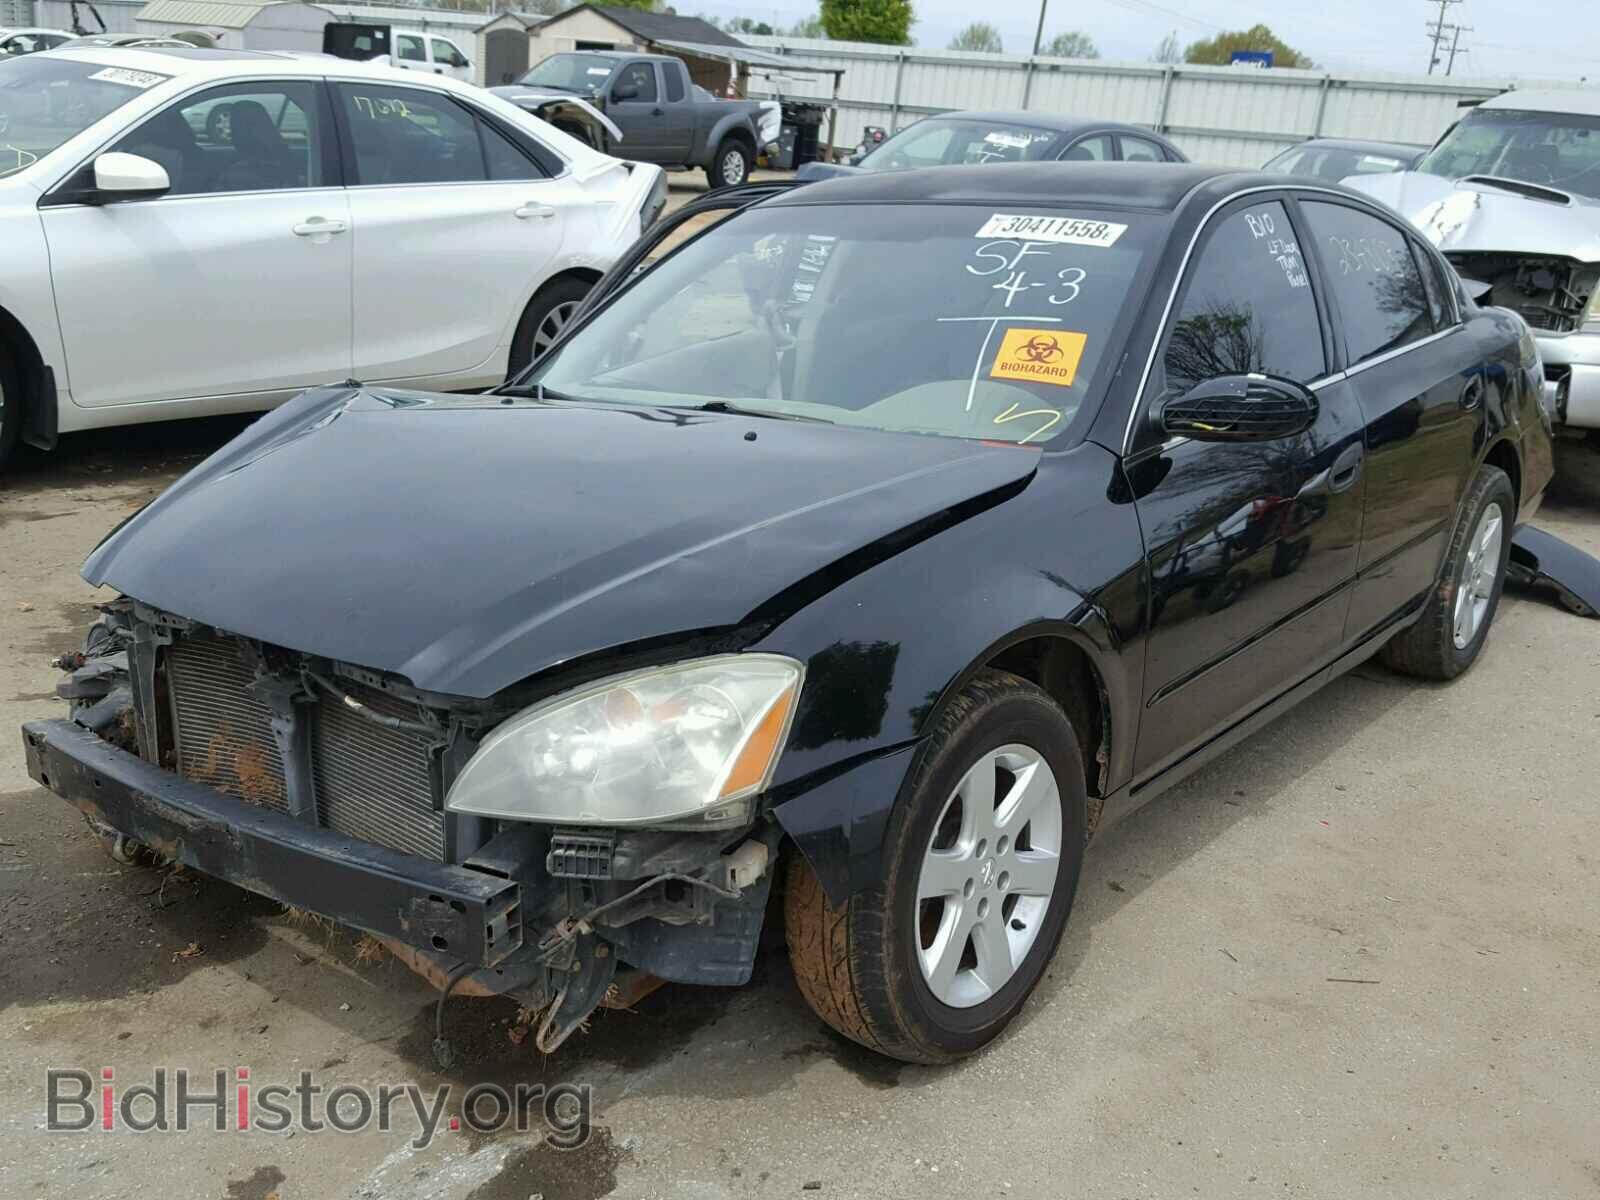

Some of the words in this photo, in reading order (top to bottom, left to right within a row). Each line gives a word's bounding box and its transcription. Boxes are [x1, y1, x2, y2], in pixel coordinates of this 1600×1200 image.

[1002, 216, 1109, 240] 30411558
[965, 238, 1060, 276] SF
[992, 267, 1087, 309] 4-3
[1000, 361, 1068, 379] BIOHAZARD
